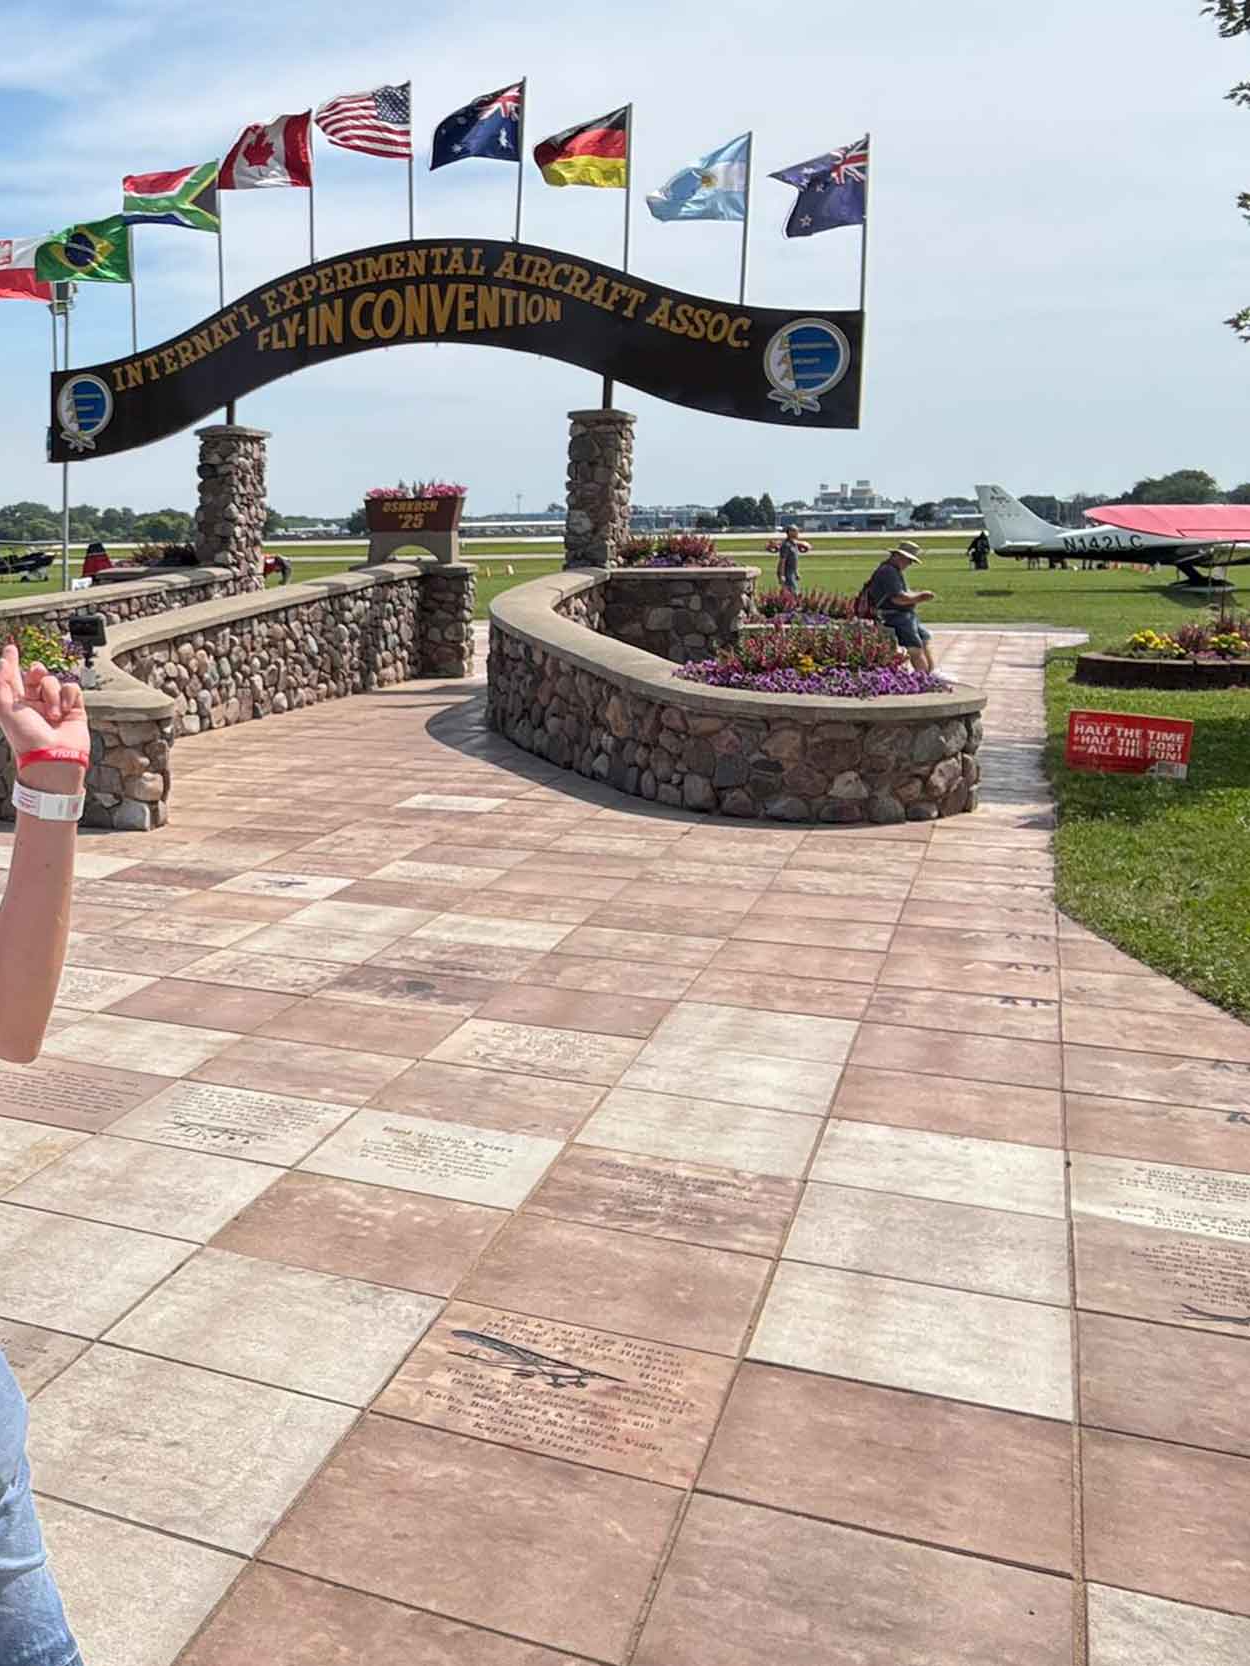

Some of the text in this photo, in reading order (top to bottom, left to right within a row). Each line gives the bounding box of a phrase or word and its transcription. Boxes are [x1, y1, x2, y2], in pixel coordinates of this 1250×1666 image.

[112, 247, 751, 391] INTERNAT'L EXPERIMENTAL AIRCRAFT ASSOC.
[257, 283, 562, 350] FLY-IN CONVENTION
[1063, 534, 1143, 552] N142LC
[1074, 723, 1185, 743] HALF THE TIME
[1148, 742, 1183, 753] COST
[442, 1366, 485, 1381] Thank
